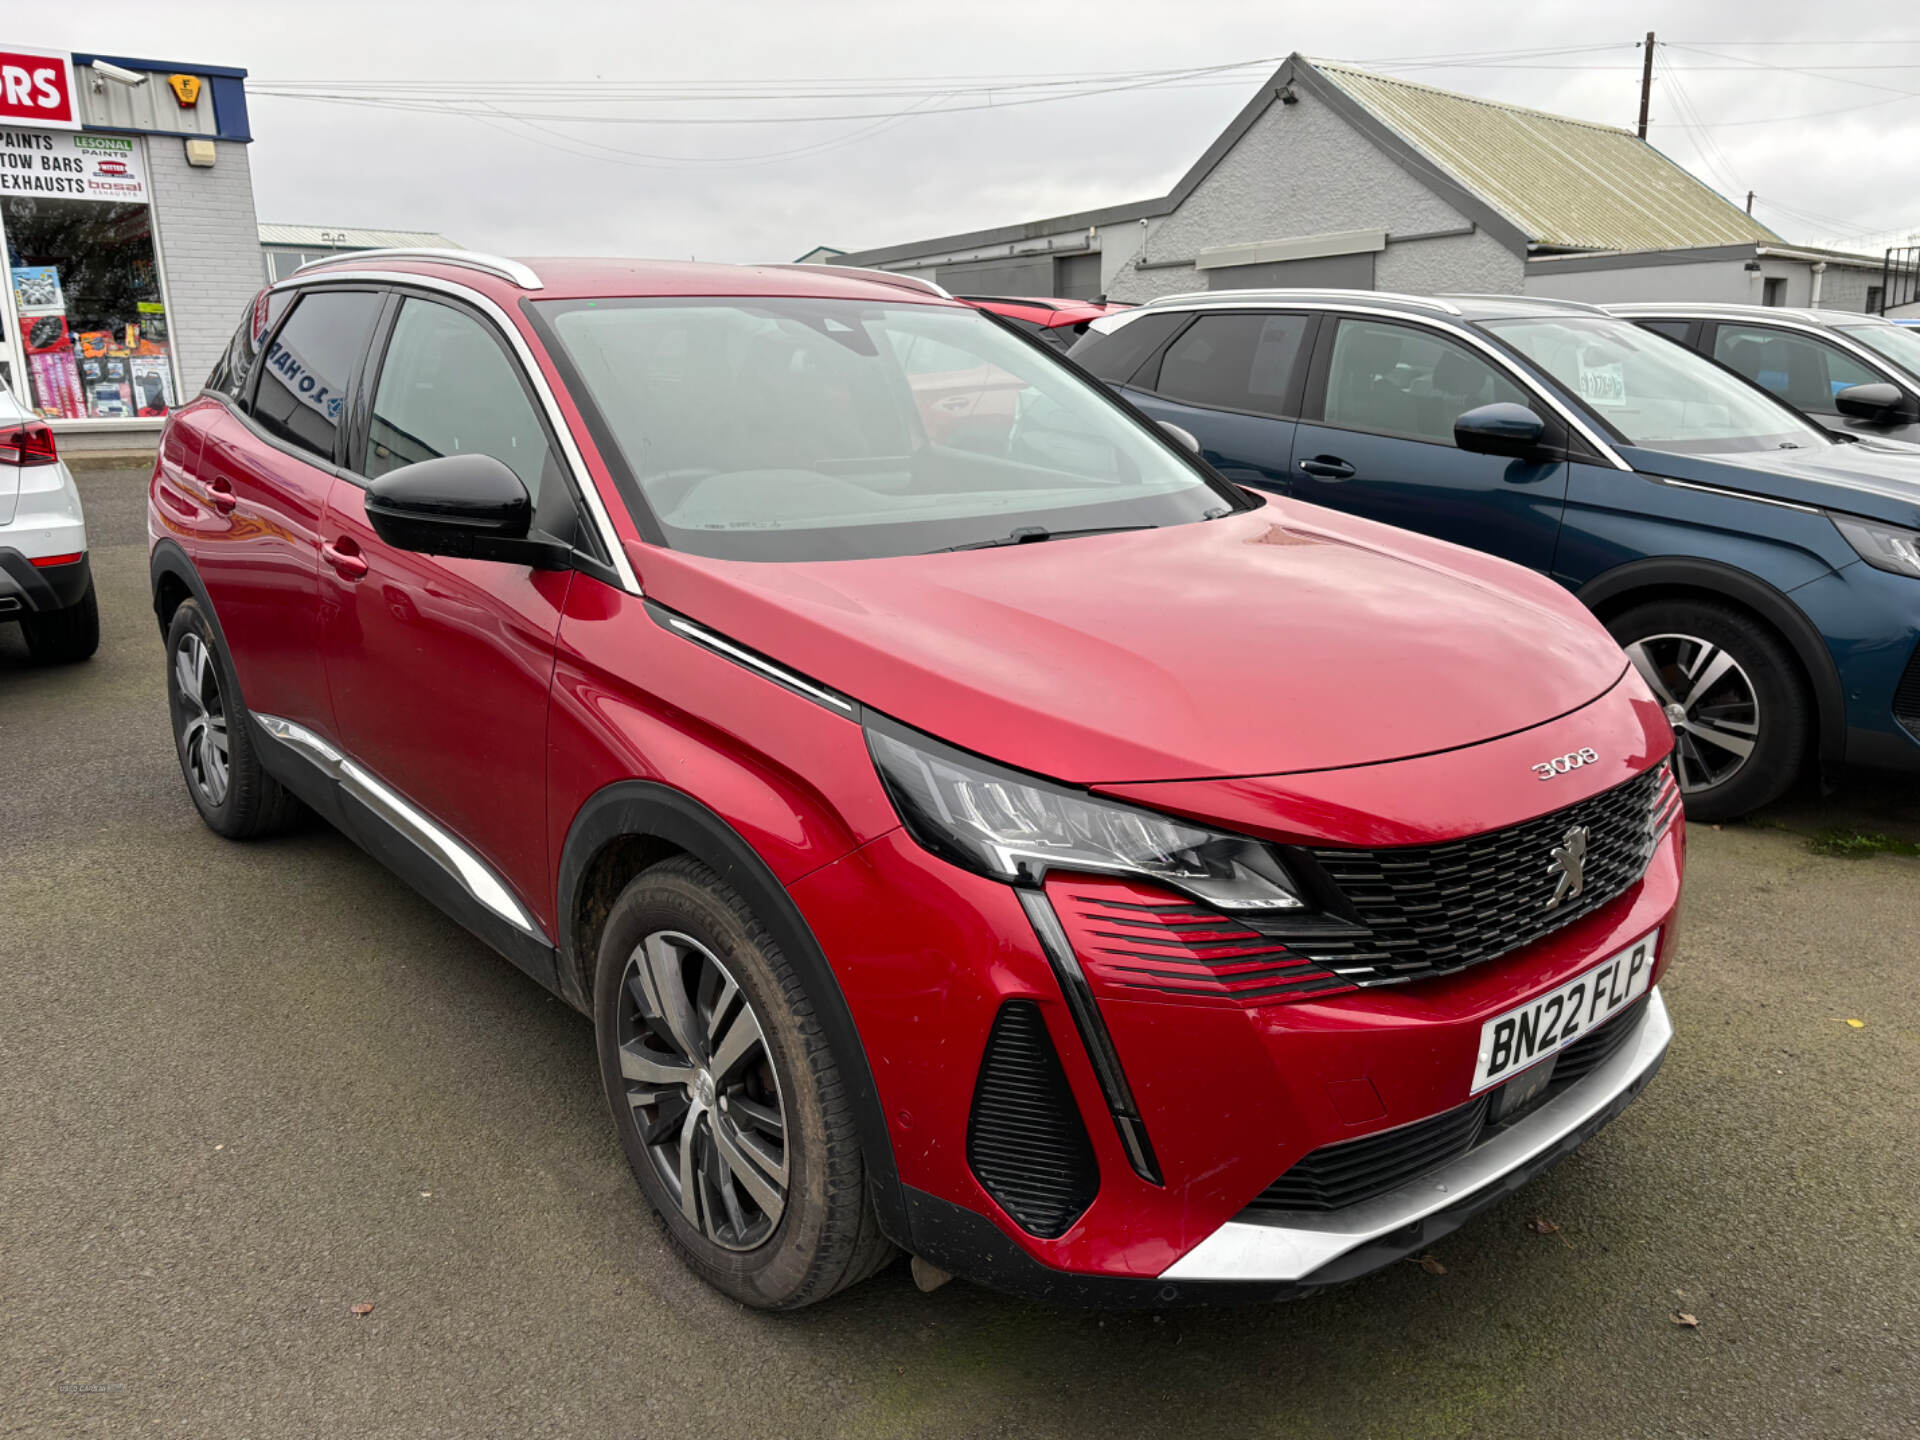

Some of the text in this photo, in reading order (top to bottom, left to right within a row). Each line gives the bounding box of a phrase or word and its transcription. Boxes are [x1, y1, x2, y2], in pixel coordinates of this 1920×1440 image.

[0, 65, 61, 109] RS
[76, 136, 131, 150] LESONAL
[0, 153, 83, 173] TOW BARS
[82, 149, 128, 158] PAINTS
[1, 174, 85, 193] EXHAUSTS
[88, 179, 142, 192] bosal
[1532, 747, 1600, 780] 3008
[1487, 943, 1647, 1078] BN22 FLP
